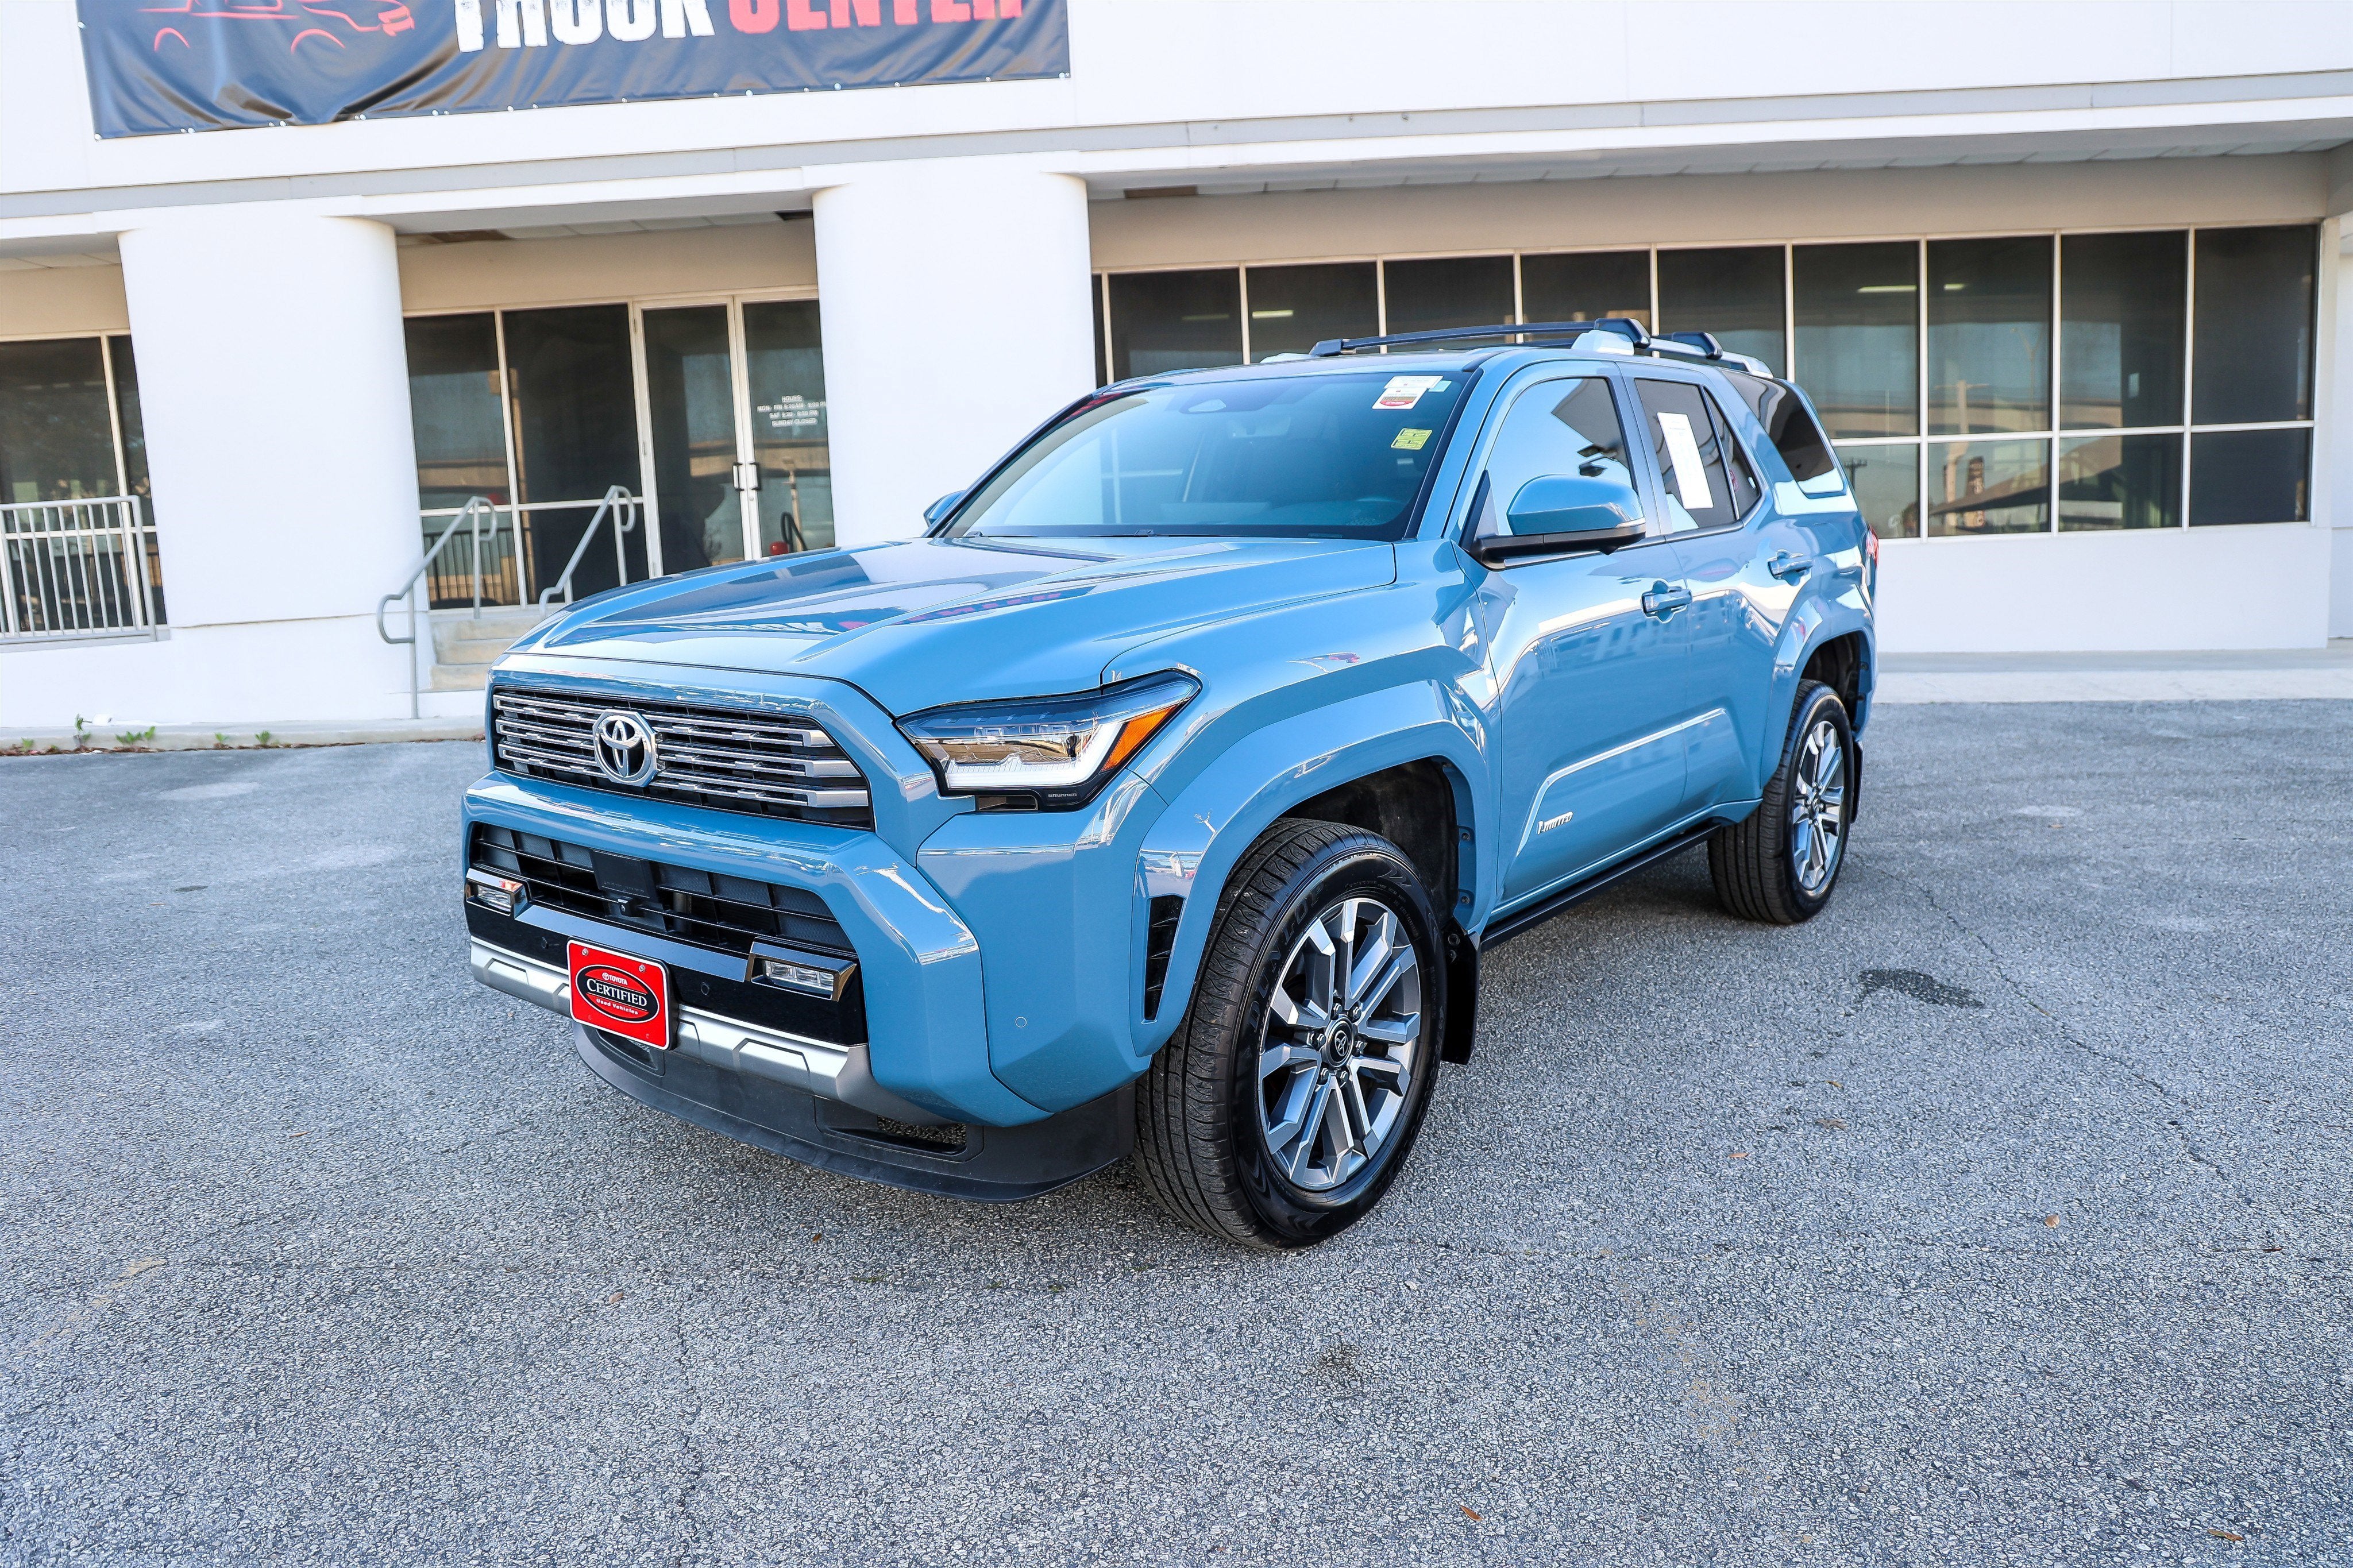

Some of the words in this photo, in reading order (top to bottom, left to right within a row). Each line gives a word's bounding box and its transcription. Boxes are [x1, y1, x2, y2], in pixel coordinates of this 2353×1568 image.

[1248, 879, 1324, 1033] DUNLOP
[609, 975, 628, 986] TOYOTA
[587, 978, 647, 1006] CERTIFIED
[596, 998, 611, 1007] Used
[612, 1003, 638, 1015] Vehicles
